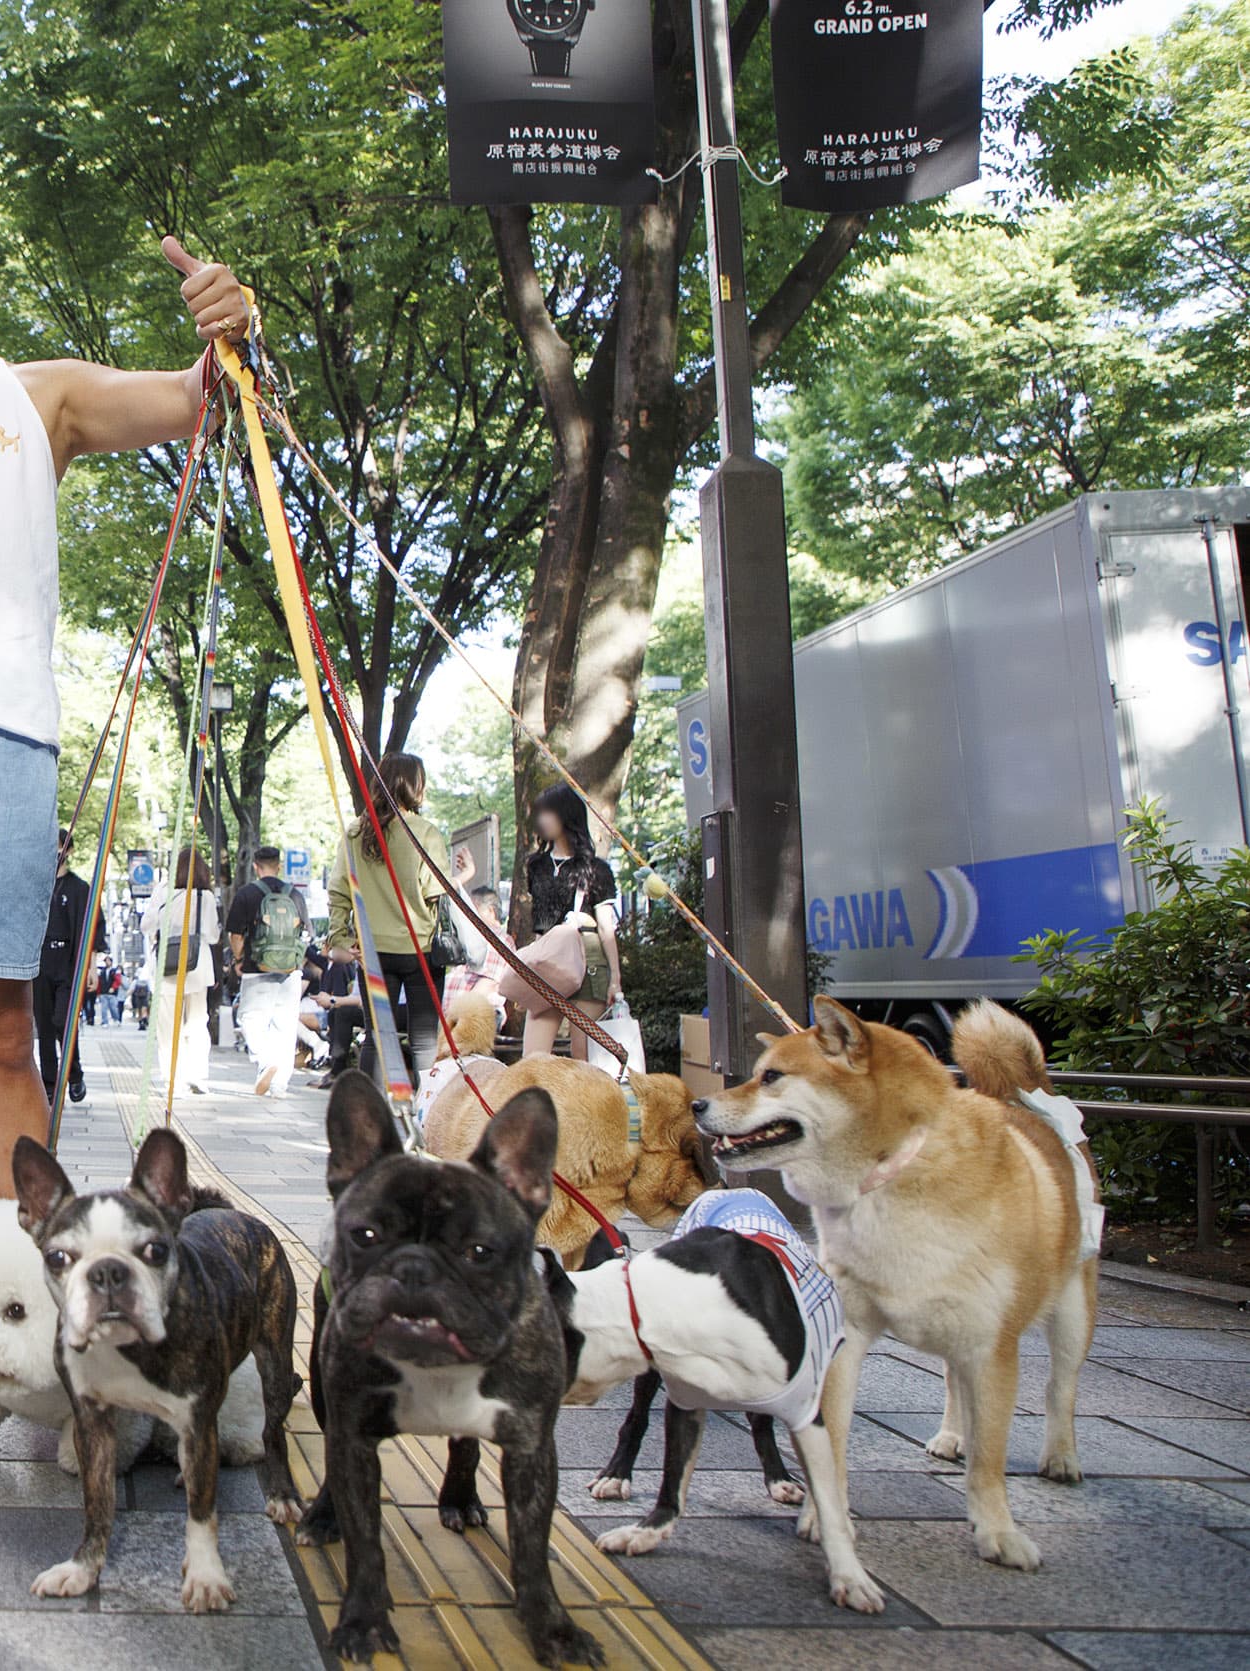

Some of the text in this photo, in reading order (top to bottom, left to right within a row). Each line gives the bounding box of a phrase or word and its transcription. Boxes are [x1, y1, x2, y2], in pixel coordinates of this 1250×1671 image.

[844, 0, 892, 15] 6.2 FRI.
[814, 13, 927, 34] GRAND OPEN
[509, 127, 598, 140] HARAJUKU
[823, 126, 918, 146] HARAJUKU
[286, 850, 308, 875] P
[806, 888, 914, 952] GAWA
